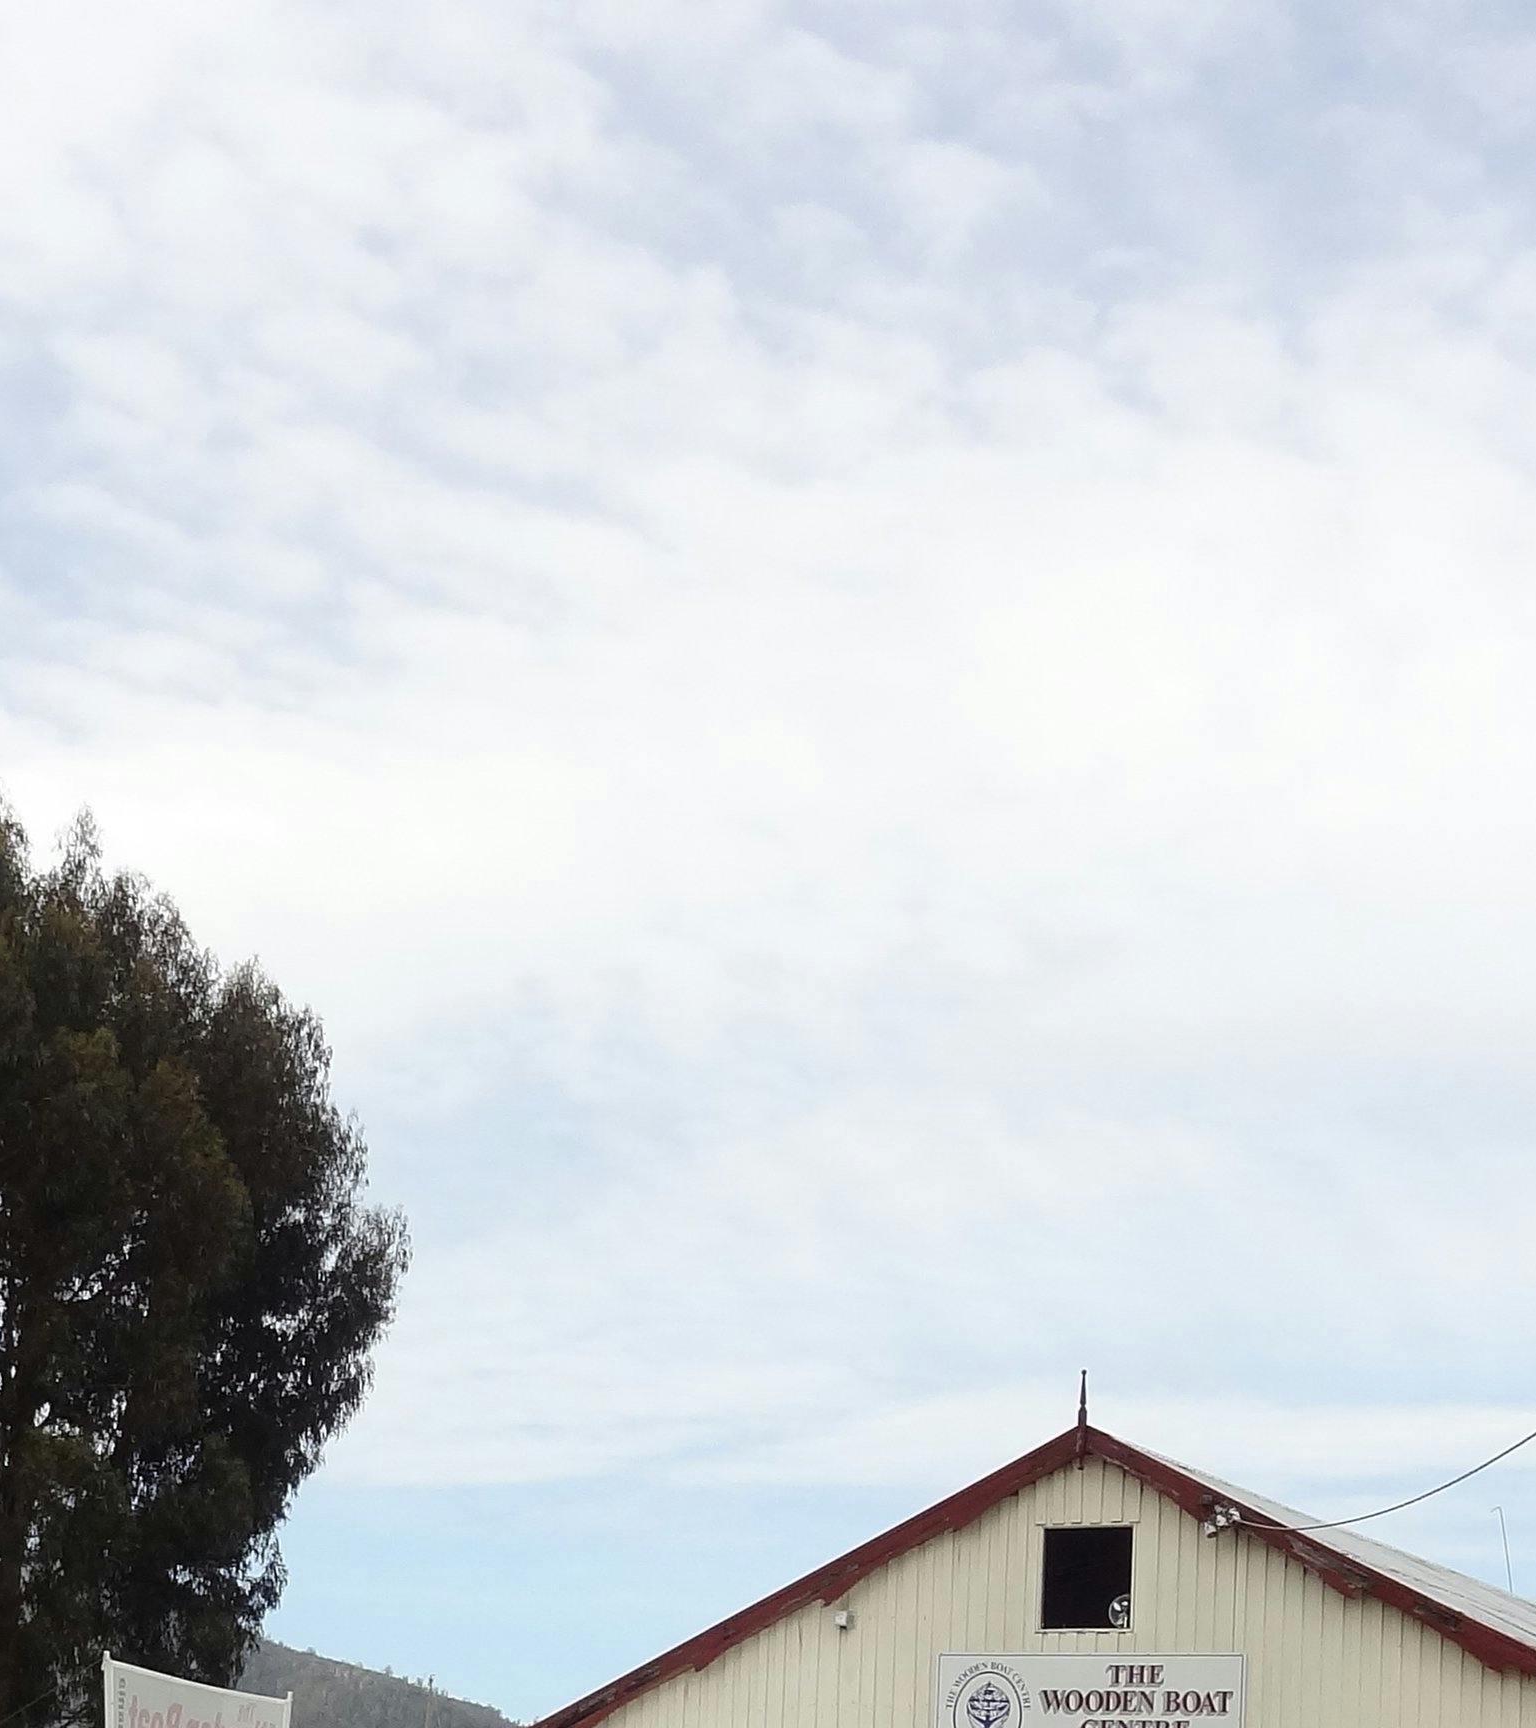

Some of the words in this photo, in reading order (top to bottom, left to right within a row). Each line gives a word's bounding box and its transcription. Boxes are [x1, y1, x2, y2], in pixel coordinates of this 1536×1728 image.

[990, 1661, 1014, 1675] BOAT
[1106, 1664, 1165, 1688] THE
[1039, 1689, 1156, 1715] WOODEN
[1162, 1690, 1234, 1716] BOAT
